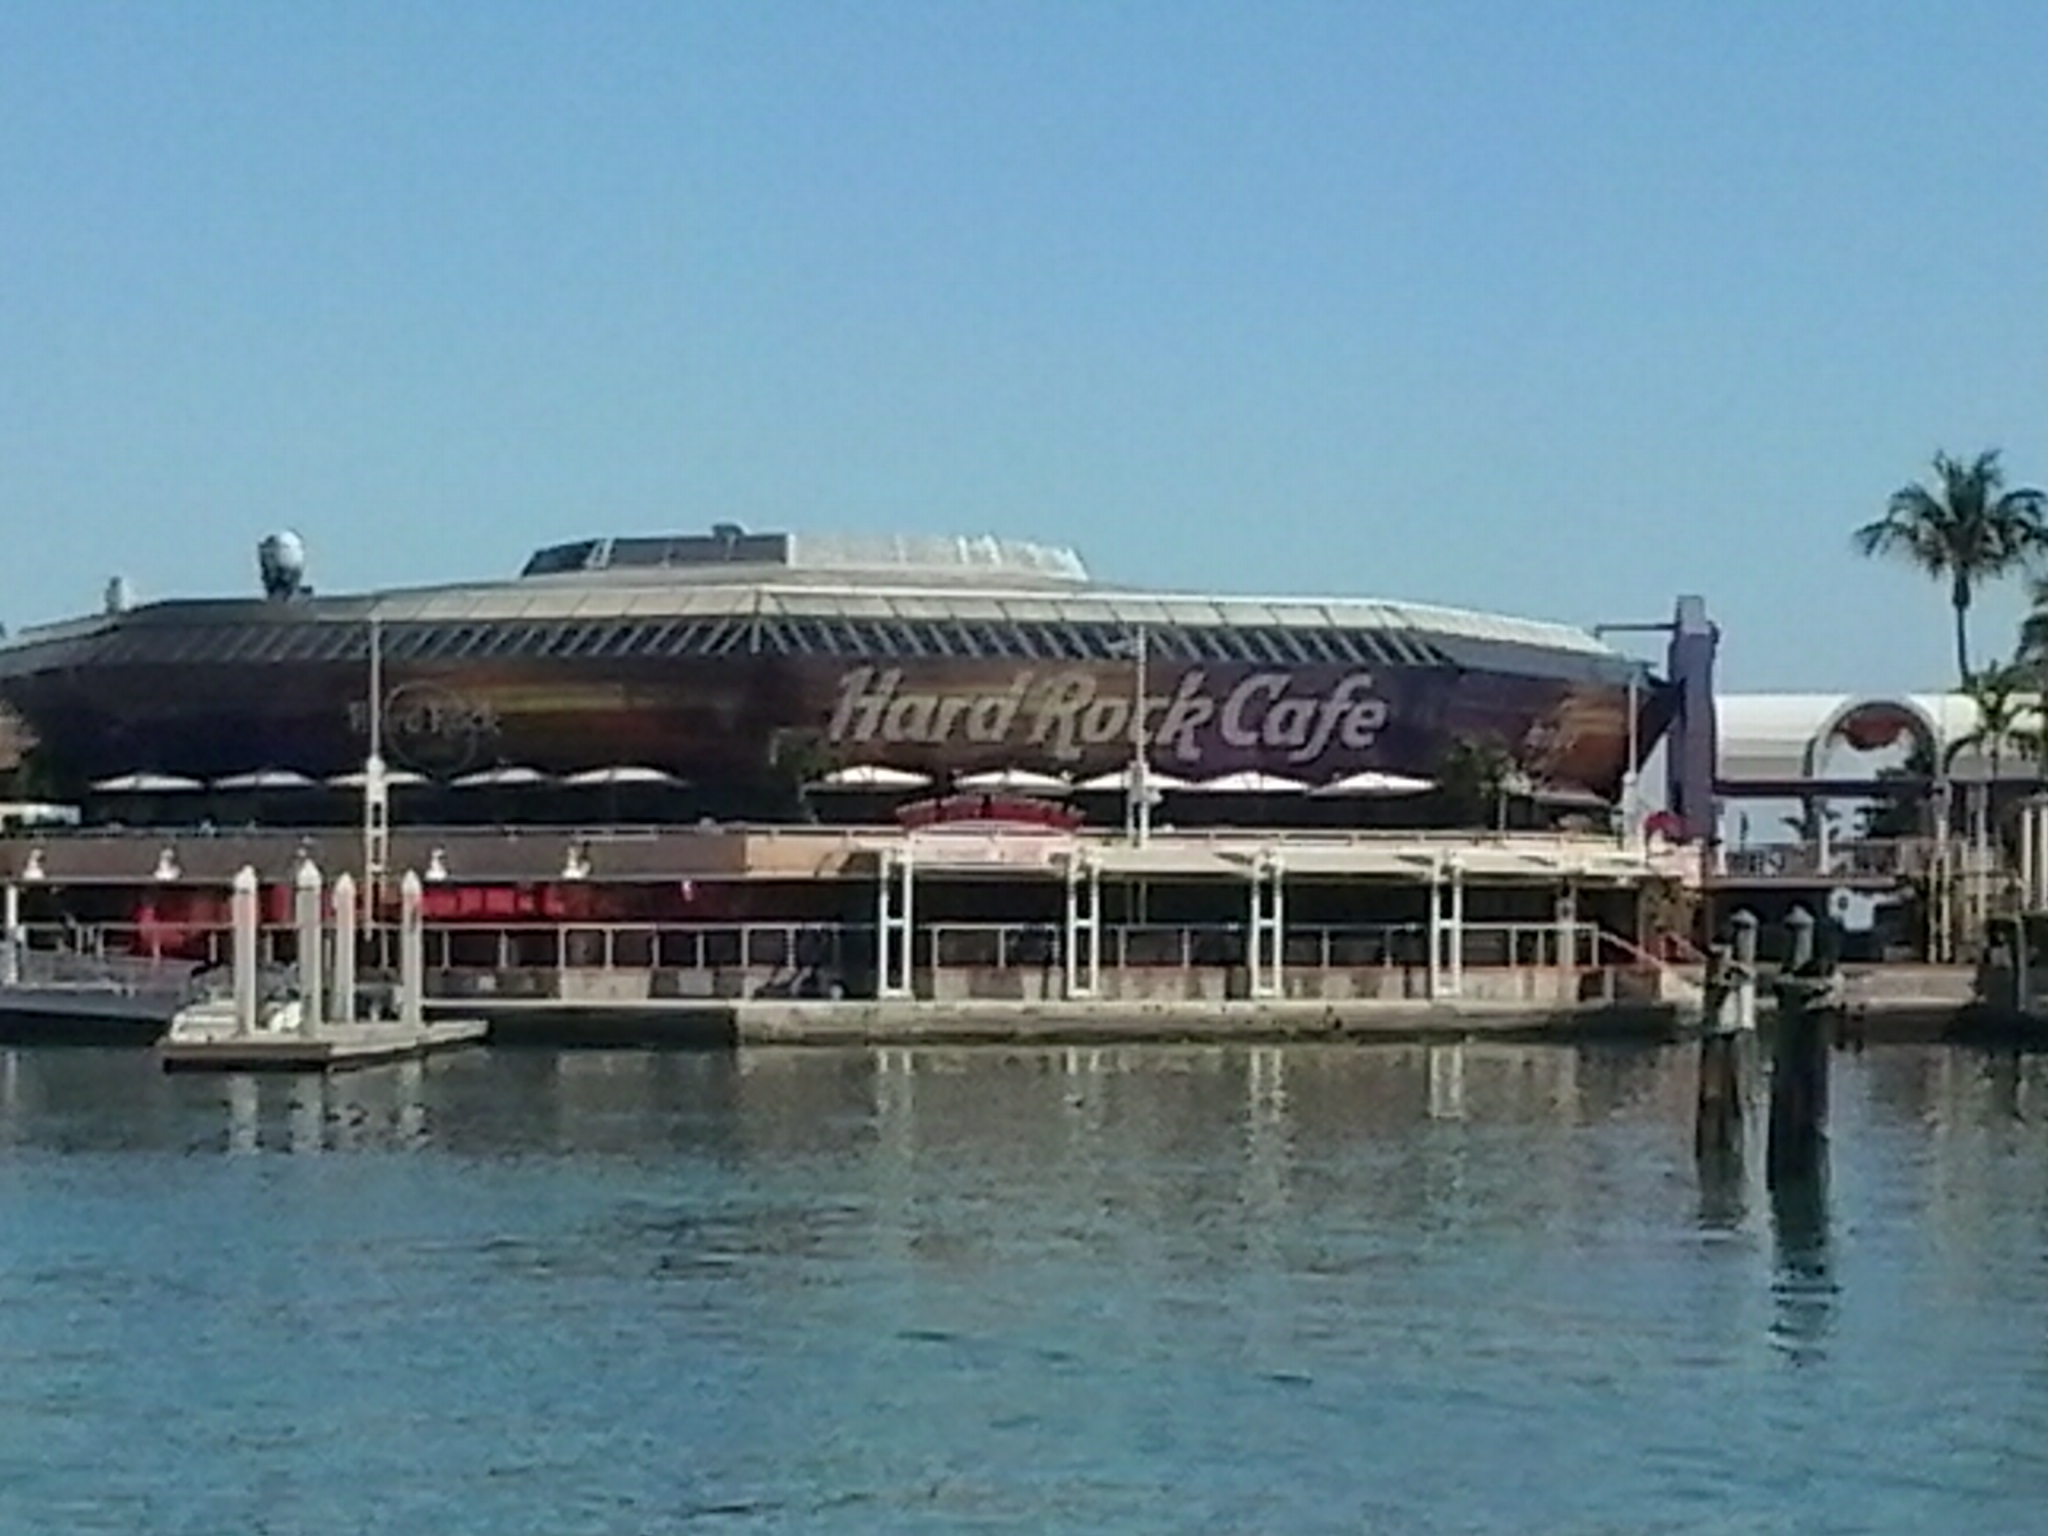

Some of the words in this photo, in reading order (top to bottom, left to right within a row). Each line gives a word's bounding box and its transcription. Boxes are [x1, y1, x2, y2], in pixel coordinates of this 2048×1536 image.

[829, 666, 1031, 744] Hard
[1028, 670, 1217, 760] Rock
[1220, 671, 1389, 761] Cafe
